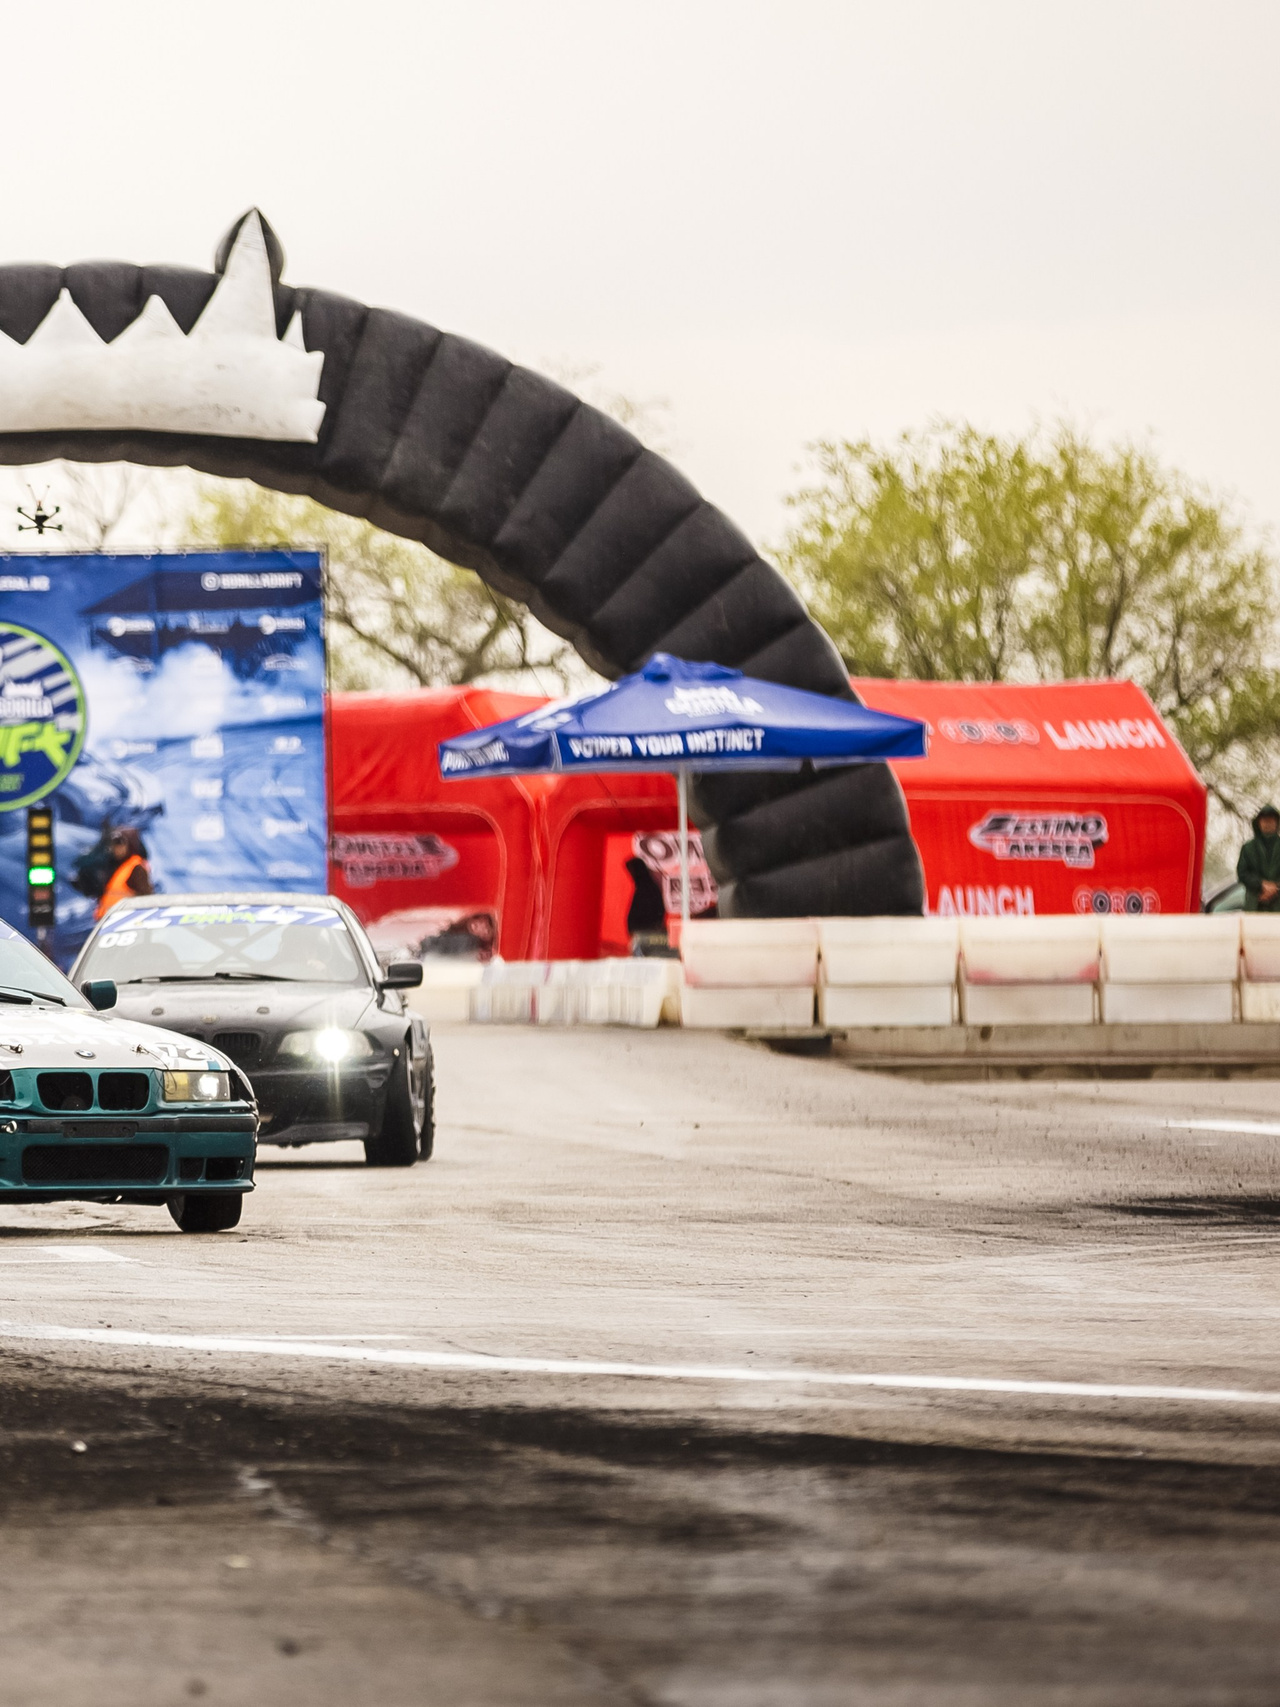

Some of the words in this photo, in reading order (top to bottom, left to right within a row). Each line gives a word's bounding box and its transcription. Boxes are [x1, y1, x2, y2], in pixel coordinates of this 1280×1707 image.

[569, 736, 632, 759] POWER
[635, 733, 684, 757] YOUR
[686, 728, 766, 754] INSTINCT
[1043, 718, 1167, 750] LAUNCH
